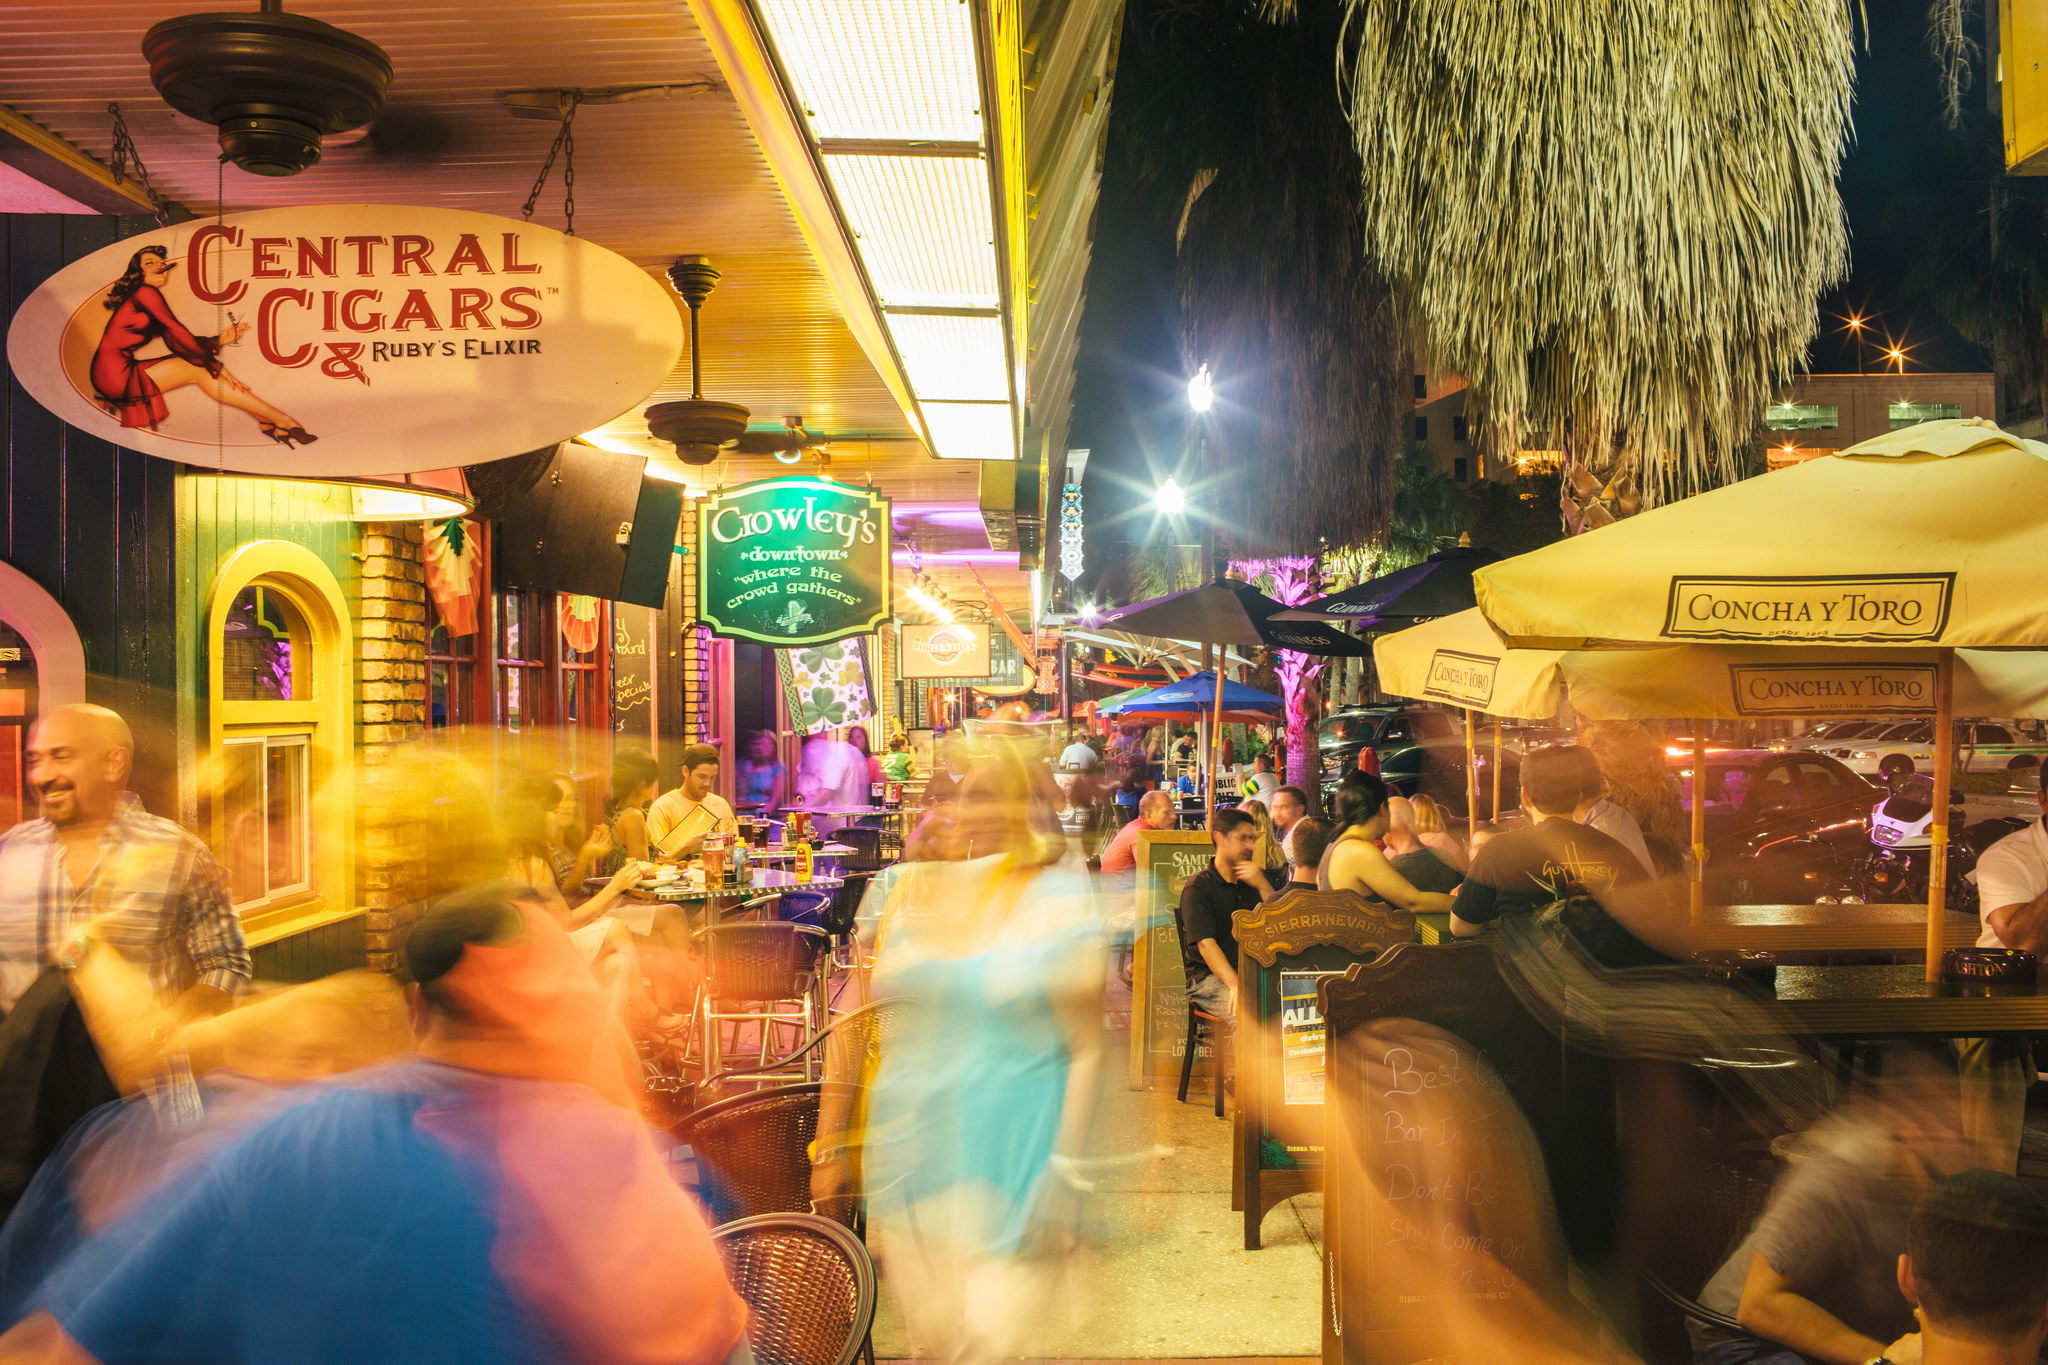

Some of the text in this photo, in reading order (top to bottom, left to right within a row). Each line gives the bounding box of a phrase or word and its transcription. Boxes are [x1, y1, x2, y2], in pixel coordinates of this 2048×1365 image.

[187, 225, 542, 306] CENTRAL
[257, 286, 542, 369] CIGARS
[320, 338, 542, 387] & RUBY'S ELIXIR
[810, 566, 843, 583] the
[726, 582, 779, 609] crowd
[1688, 593, 1924, 626] CONCHA Y TORO
[991, 659, 1017, 675] BAR
[1749, 675, 1925, 701] CONCHA Y TORO
[1172, 851, 1216, 867] SAMU
[1264, 913, 1387, 939] SIERRA NEVADA
[1955, 959, 2005, 977] ASHTON
[1384, 1047, 1464, 1098] Best
[1384, 1110, 1429, 1144] Bar
[1384, 1163, 1454, 1204] Don't
[1441, 1222, 1493, 1255] Come
